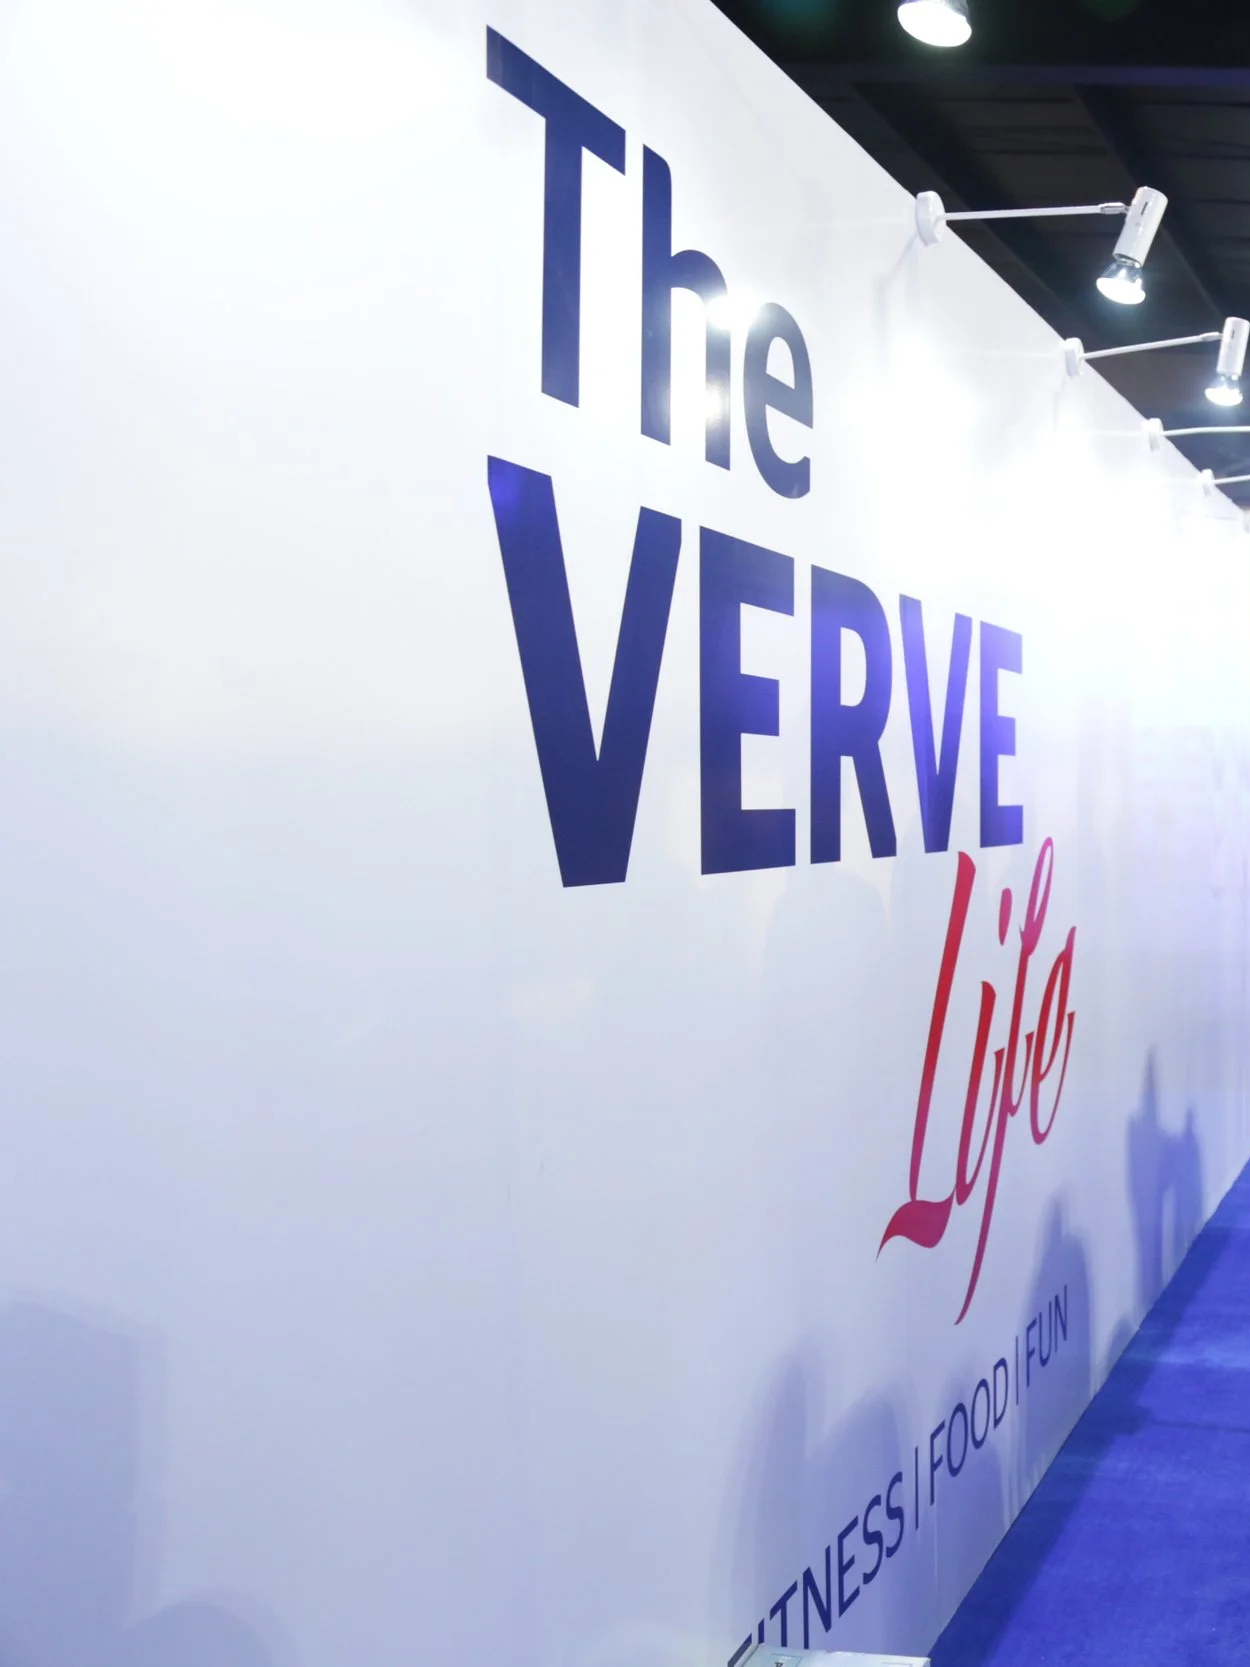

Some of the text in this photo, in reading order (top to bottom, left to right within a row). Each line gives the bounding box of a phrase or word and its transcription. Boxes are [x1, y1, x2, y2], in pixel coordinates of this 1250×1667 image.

[486, 25, 814, 499] The
[487, 455, 1024, 888] VERVE
[876, 837, 1077, 1325] Life
[727, 1472, 905, 1667] TNESS
[929, 1357, 1009, 1505] FOOD
[1026, 1284, 1068, 1388] FUN
